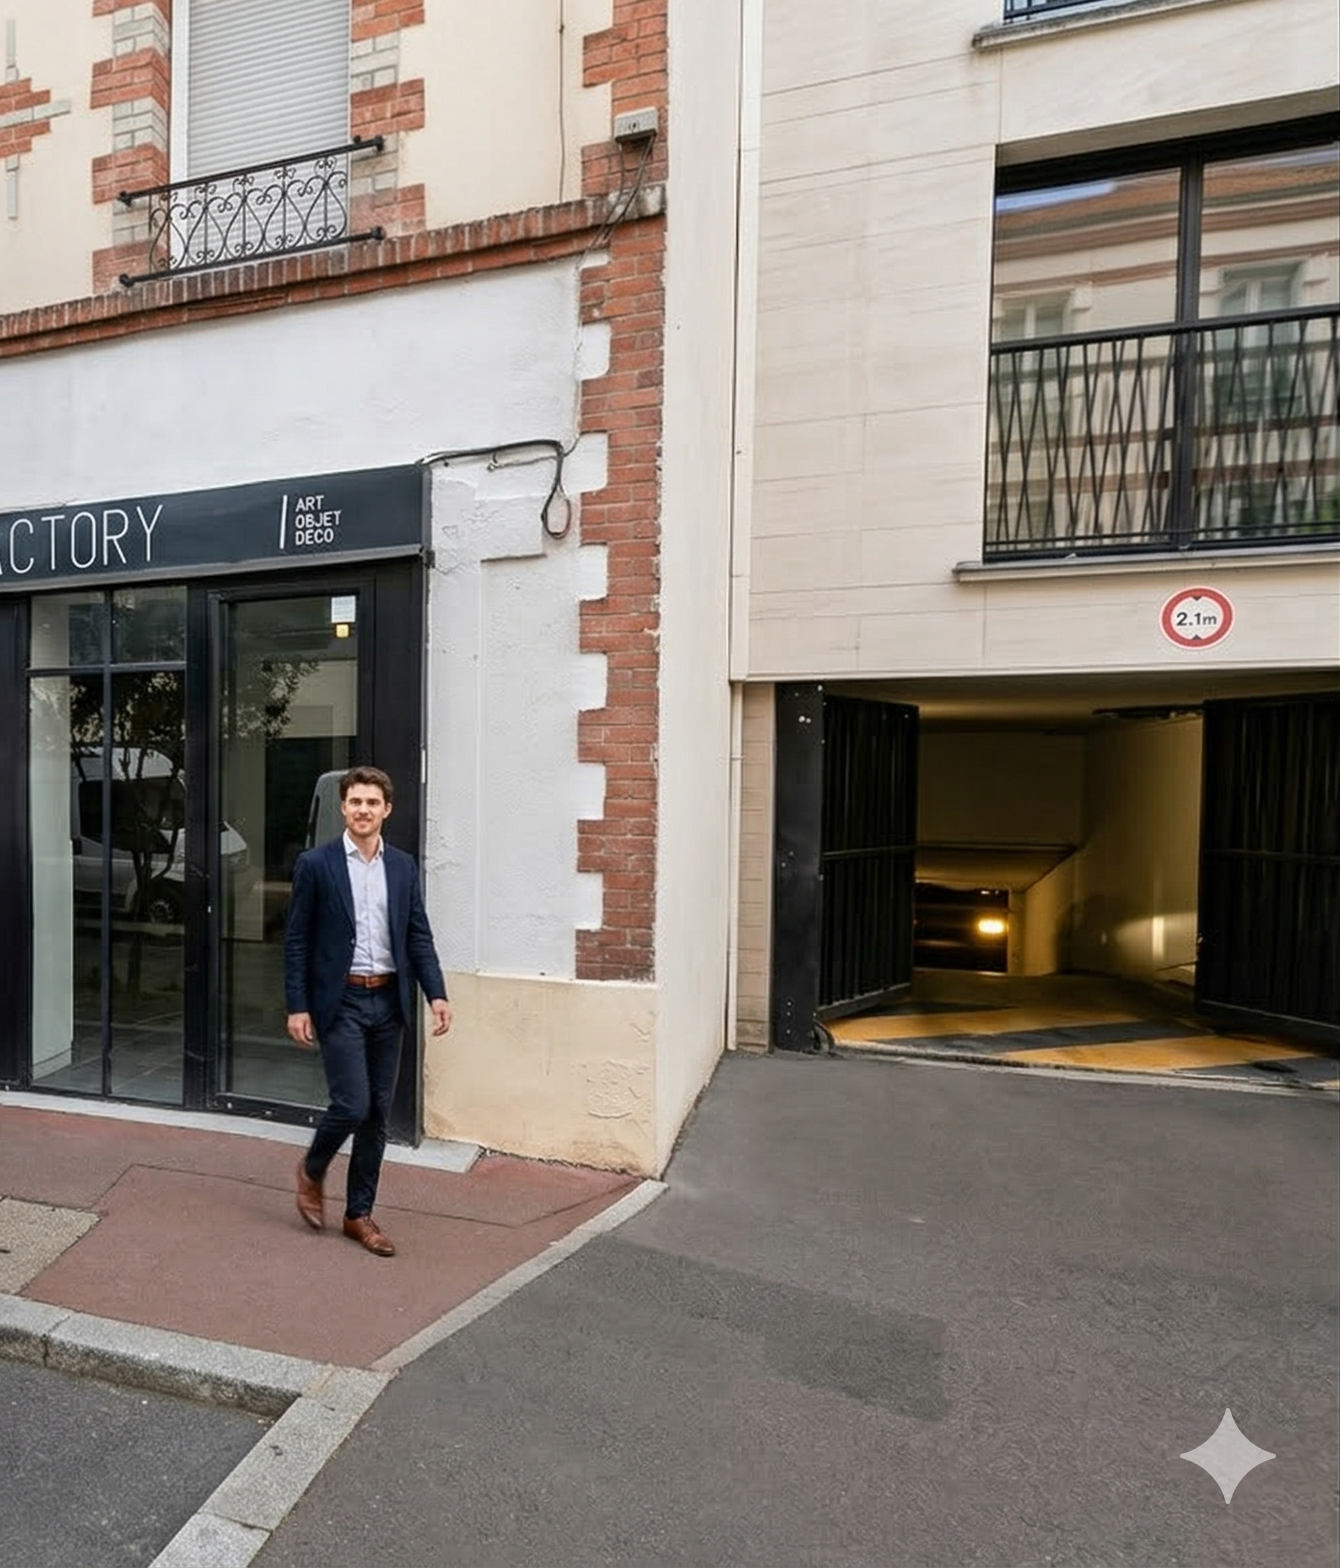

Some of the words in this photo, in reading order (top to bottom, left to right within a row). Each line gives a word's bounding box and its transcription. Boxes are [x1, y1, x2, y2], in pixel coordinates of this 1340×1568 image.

[295, 494, 325, 512] ART
[295, 510, 342, 529] OBJET
[295, 528, 334, 545] DECO
[1176, 611, 1217, 626] 2.1m
